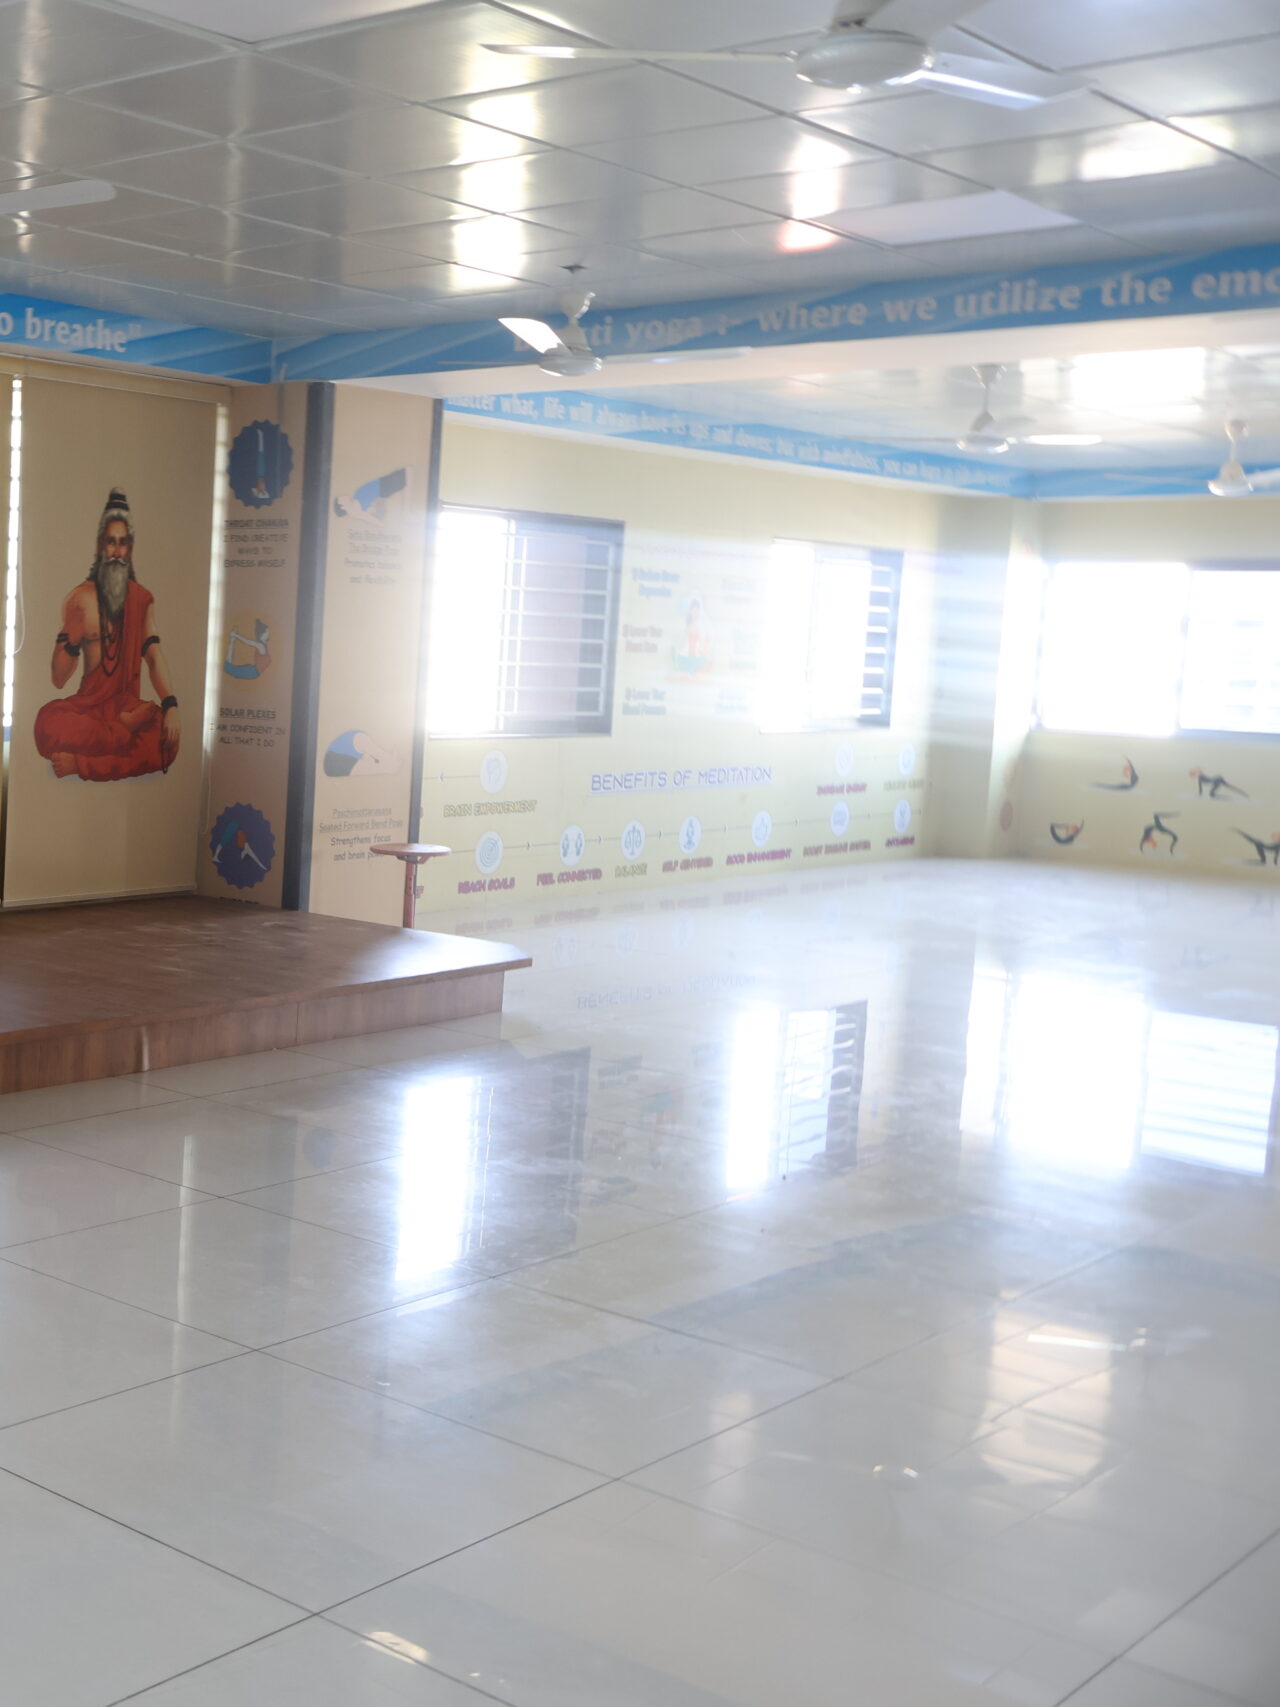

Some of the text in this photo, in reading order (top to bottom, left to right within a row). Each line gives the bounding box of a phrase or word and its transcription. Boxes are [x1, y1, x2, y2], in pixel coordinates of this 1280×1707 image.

[623, 317, 704, 347] yoga
[755, 301, 868, 332] where
[883, 296, 938, 323] we
[955, 277, 1082, 319] utilize
[1100, 271, 1174, 308] the
[590, 765, 772, 792] BENEFITS OF MEDITATION
